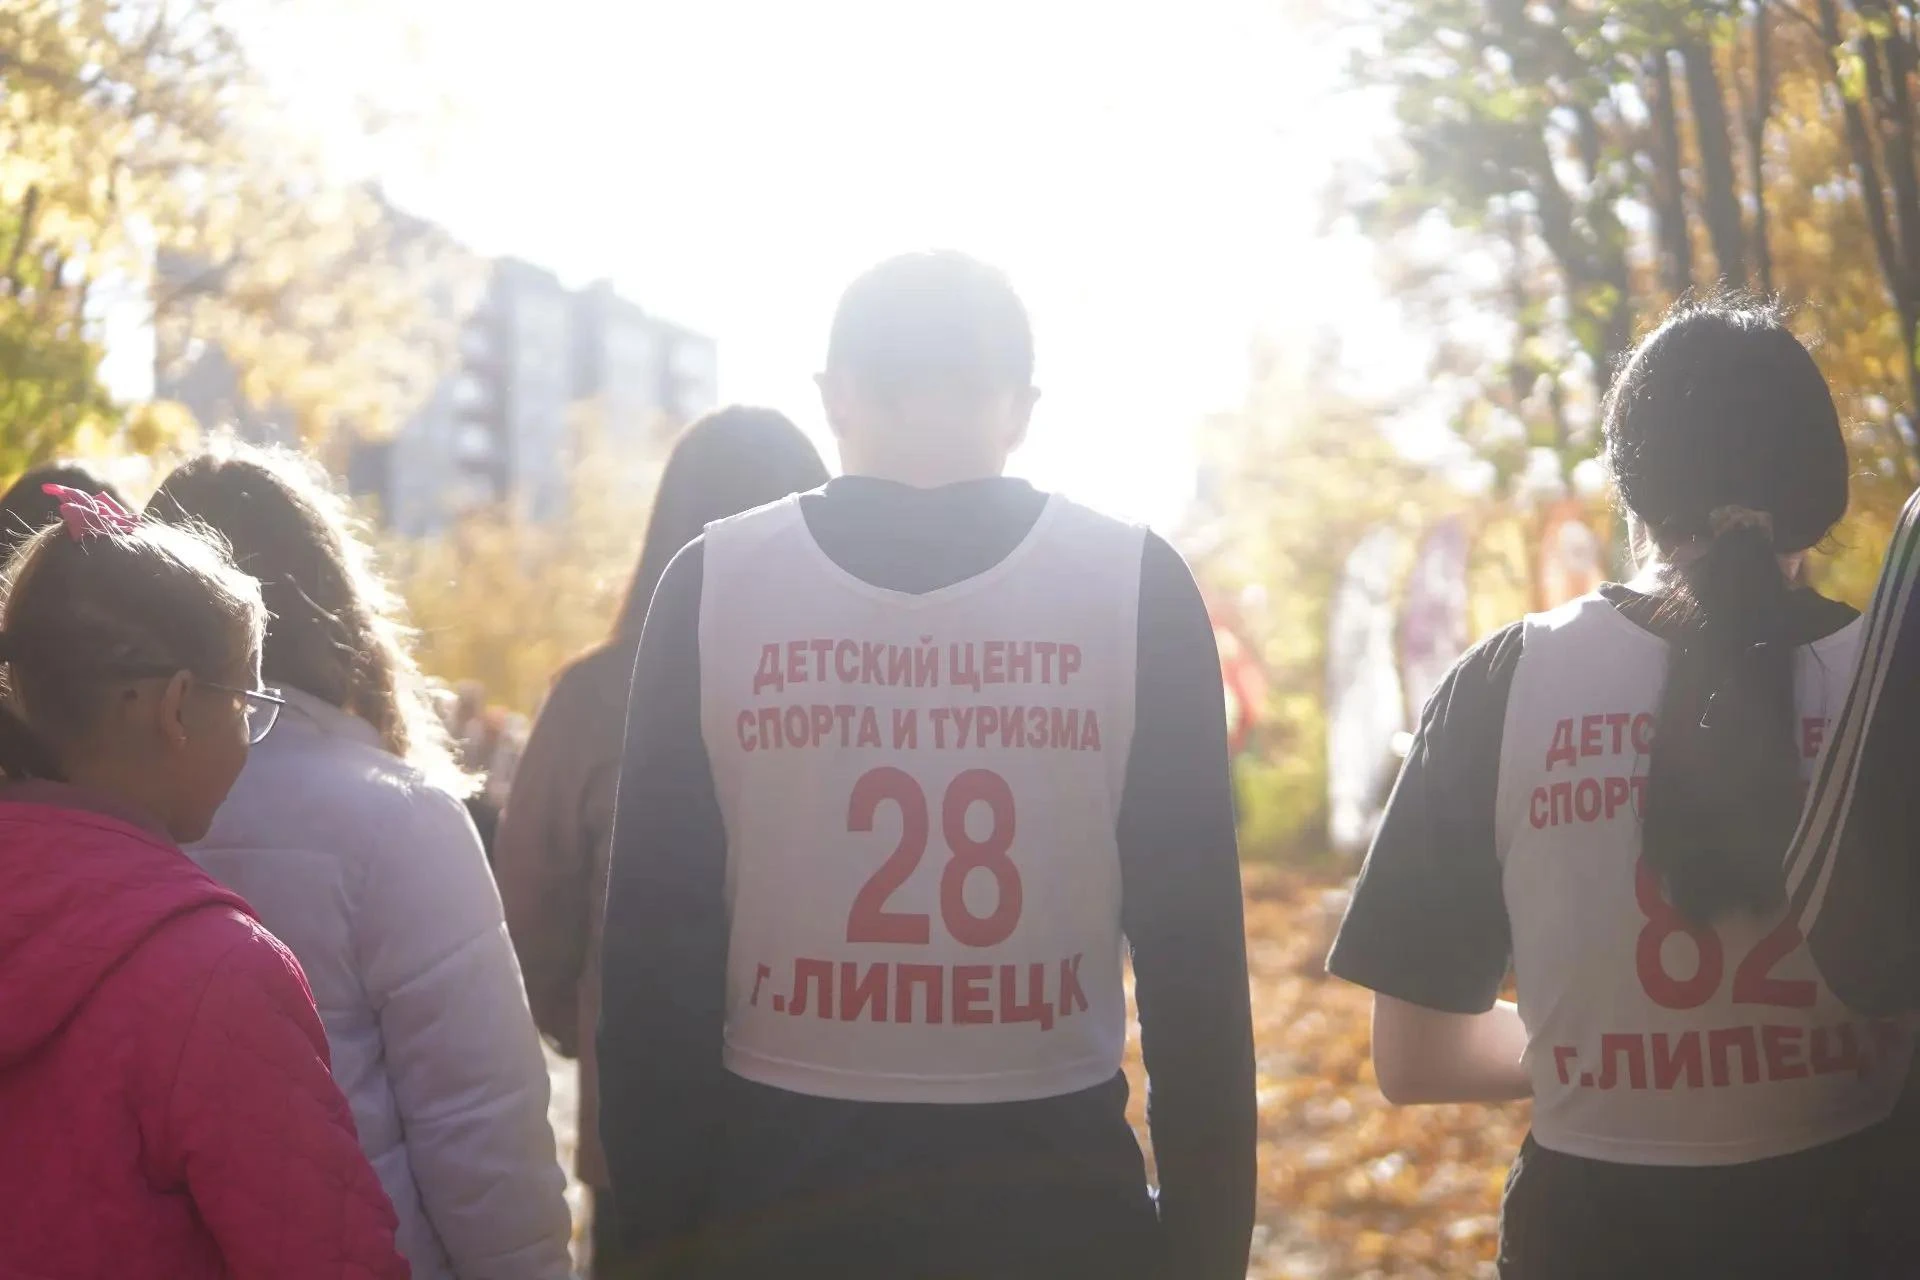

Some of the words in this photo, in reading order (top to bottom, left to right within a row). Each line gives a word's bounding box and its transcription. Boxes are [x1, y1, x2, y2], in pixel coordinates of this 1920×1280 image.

[753, 635, 939, 694] ДЕТСКИЙ
[949, 640, 1082, 692] ЦЕНТР
[737, 704, 882, 752] СПОРТА
[893, 708, 917, 749] И
[929, 705, 1101, 751] ТУРИЗМА
[1546, 713, 1656, 771] ДЕТС
[1529, 776, 1649, 829] СПОРТ
[846, 766, 1023, 948] 28
[750, 953, 1088, 1031] г.ЛИПЕЦК
